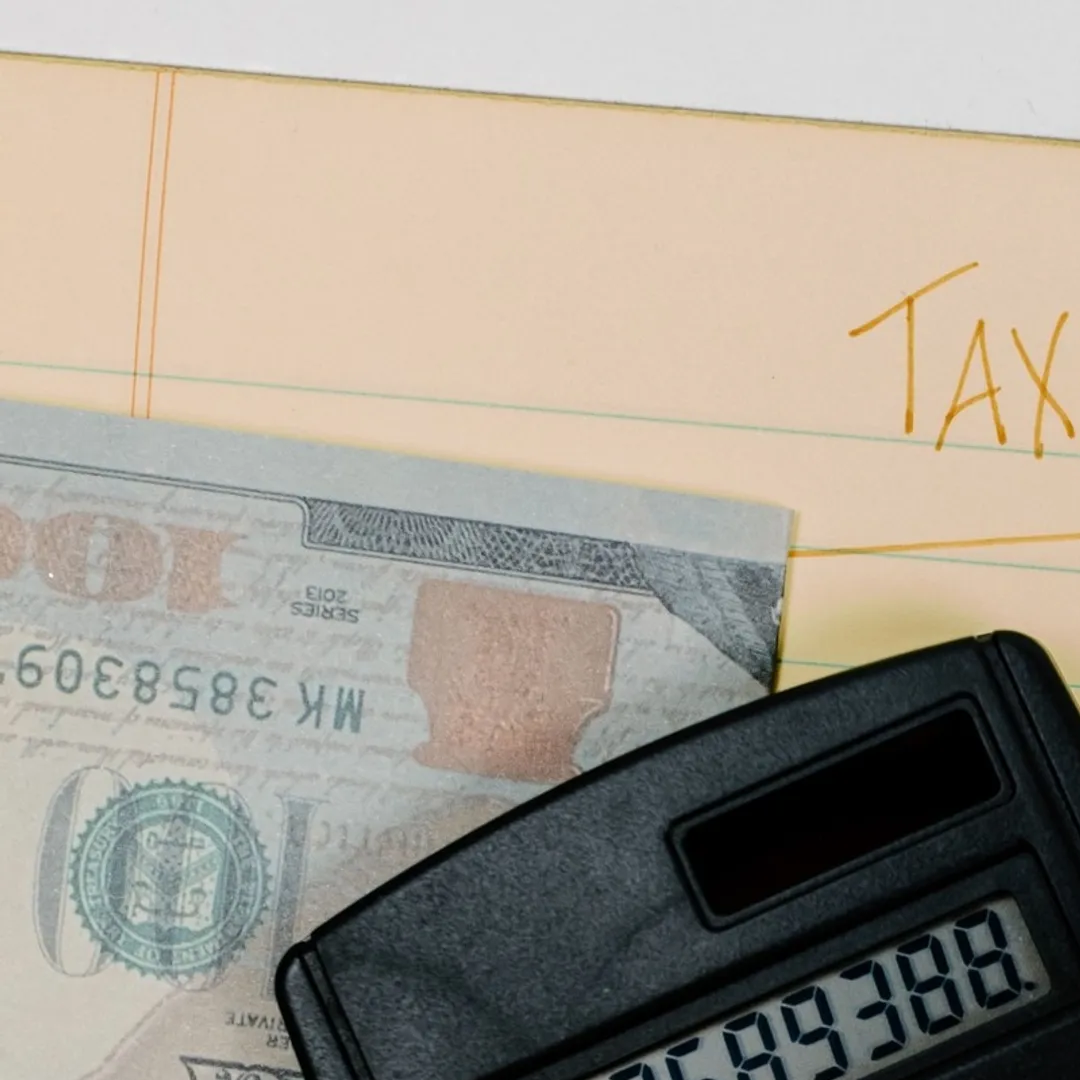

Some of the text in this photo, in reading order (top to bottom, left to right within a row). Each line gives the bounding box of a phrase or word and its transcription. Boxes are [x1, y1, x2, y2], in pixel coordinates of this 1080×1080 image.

[304, 584, 348, 604] 2013
[290, 601, 360, 625] SERIES
[0, 644, 365, 733] MK 3858309
